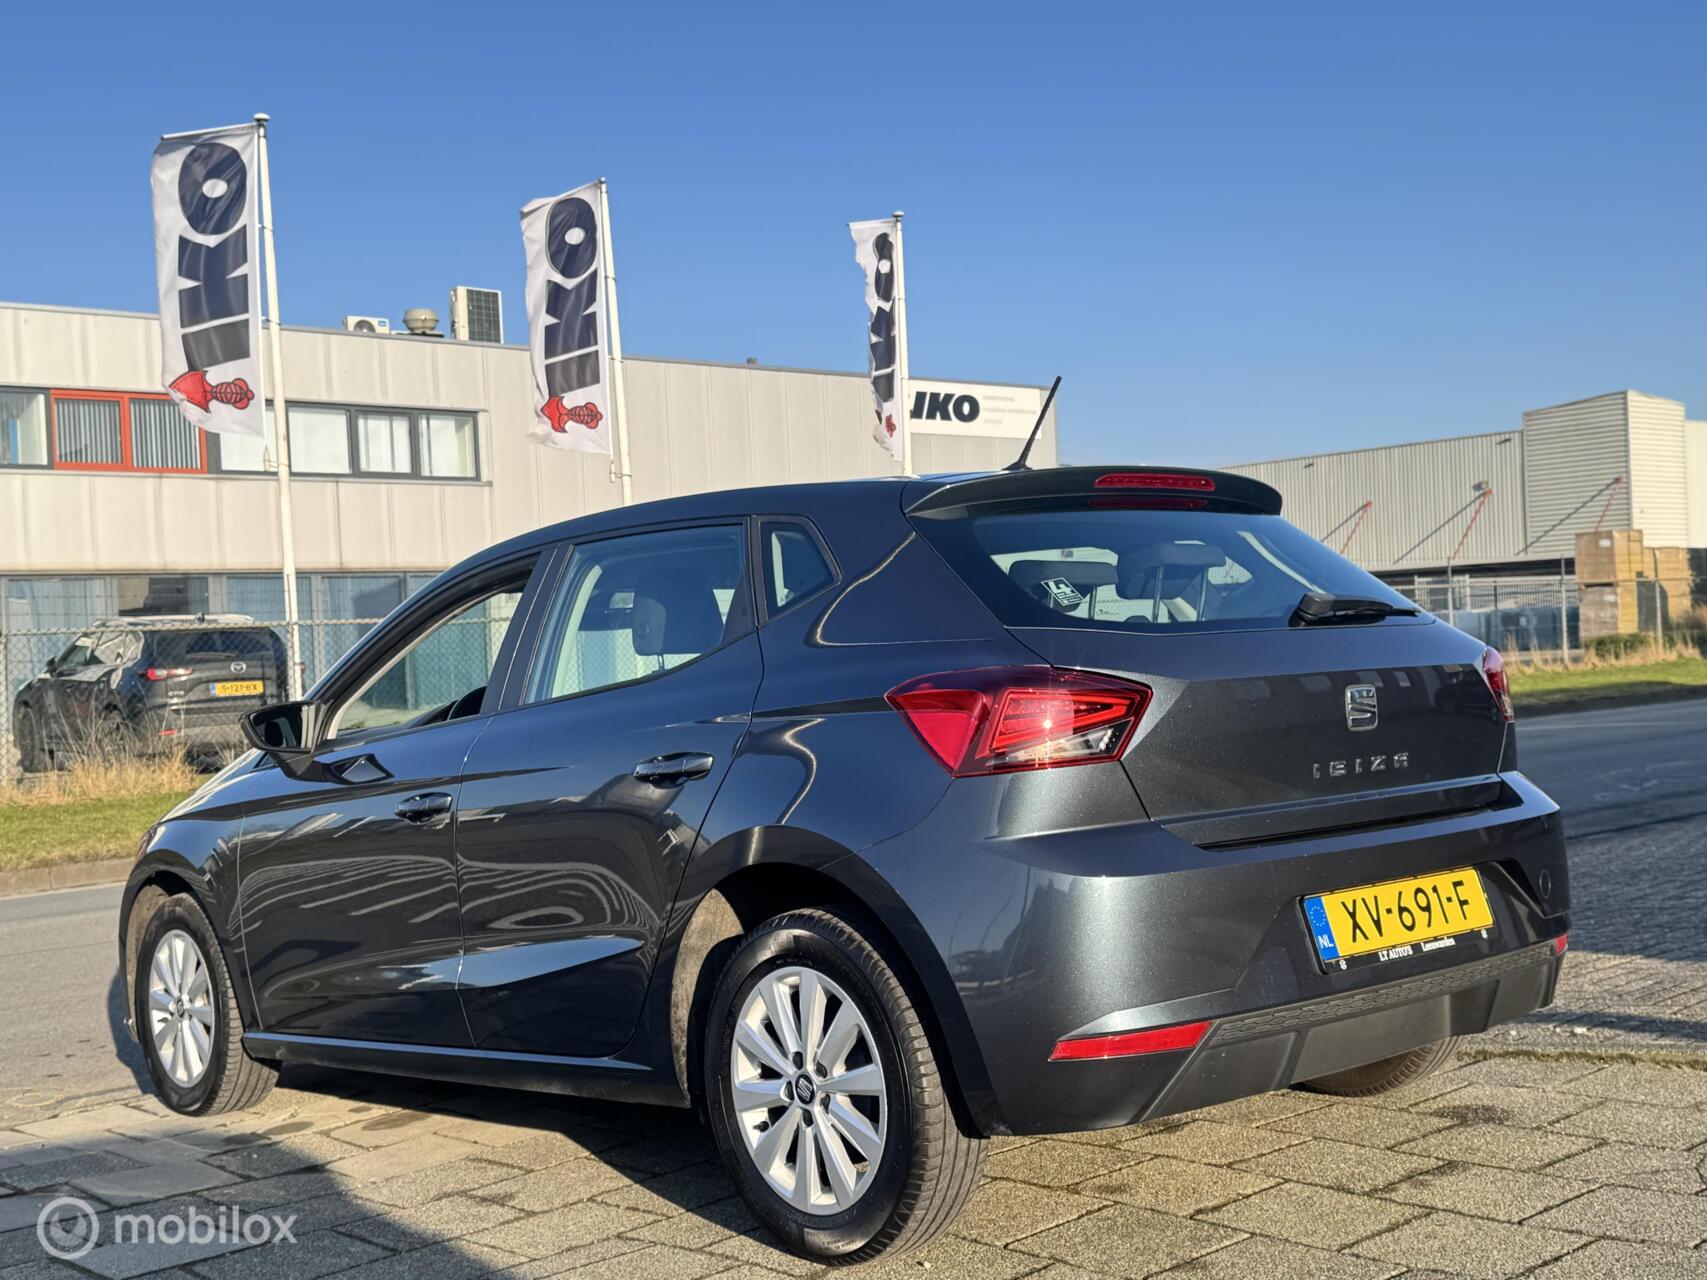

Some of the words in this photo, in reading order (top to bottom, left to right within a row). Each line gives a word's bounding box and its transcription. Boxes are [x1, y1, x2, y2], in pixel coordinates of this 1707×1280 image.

[177, 141, 250, 371] IKO
[544, 197, 601, 397] IKO
[911, 391, 980, 423] IKO
[1312, 752, 1409, 780] IBIZA
[1341, 880, 1470, 943] XV-691-F
[1318, 934, 1334, 949] NL
